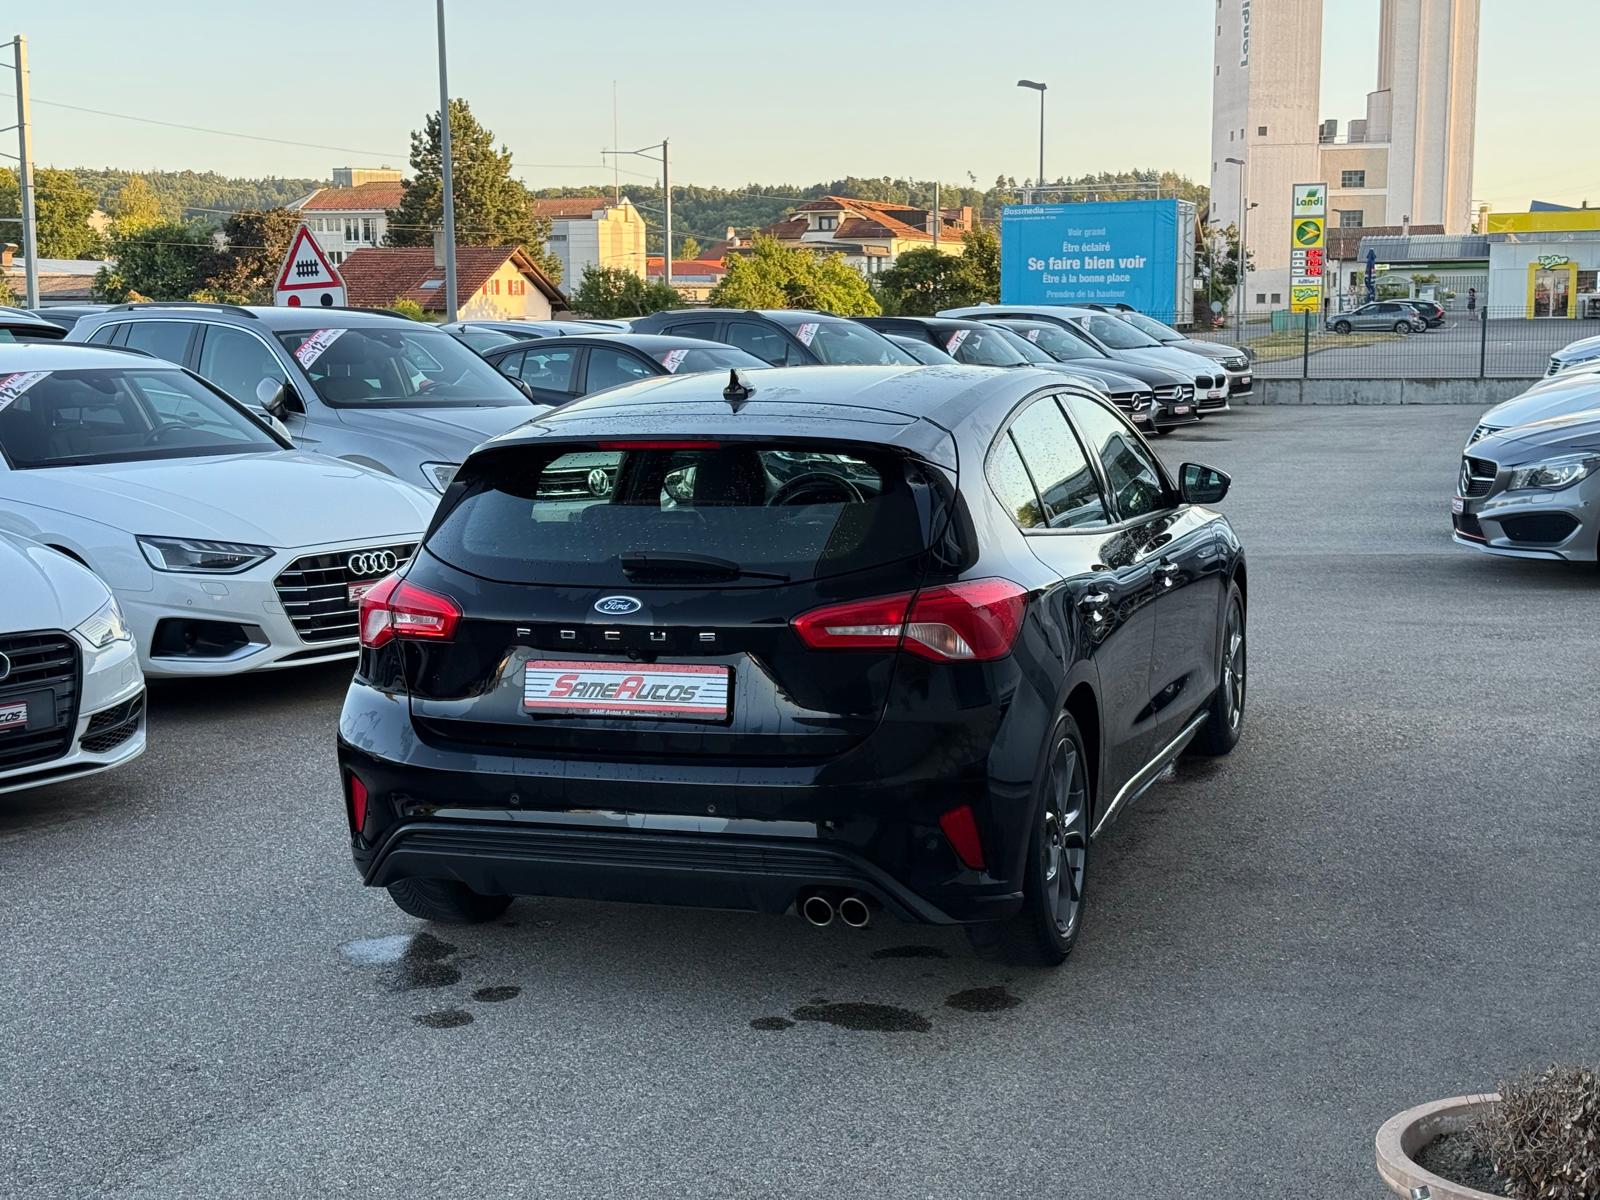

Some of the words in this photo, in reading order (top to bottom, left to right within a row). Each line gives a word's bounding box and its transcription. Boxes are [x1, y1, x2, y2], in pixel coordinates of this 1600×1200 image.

[1241, 1, 1250, 67] Landi
[1296, 196, 1323, 206] Landi
[1068, 228, 1082, 236] Voir
[1084, 227, 1106, 238] grand
[1063, 241, 1080, 252] Être
[1081, 241, 1110, 252] éclairé
[1028, 257, 1045, 271] Se
[1048, 257, 1081, 270] faire
[1084, 256, 1115, 269] bien
[1118, 255, 1147, 268] voir
[1042, 272, 1060, 284] Être
[1061, 273, 1067, 283] à
[1069, 273, 1077, 283] la
[1079, 273, 1105, 283] bonne
[1106, 272, 1130, 284] place
[1046, 290, 1075, 298] Prendre
[1076, 289, 1086, 298] de
[1087, 289, 1095, 298] la
[1096, 288, 1125, 297] hauteur
[310, 340, 328, 352] 12
[604, 600, 631, 611] Ford
[516, 628, 715, 642] FOCUS
